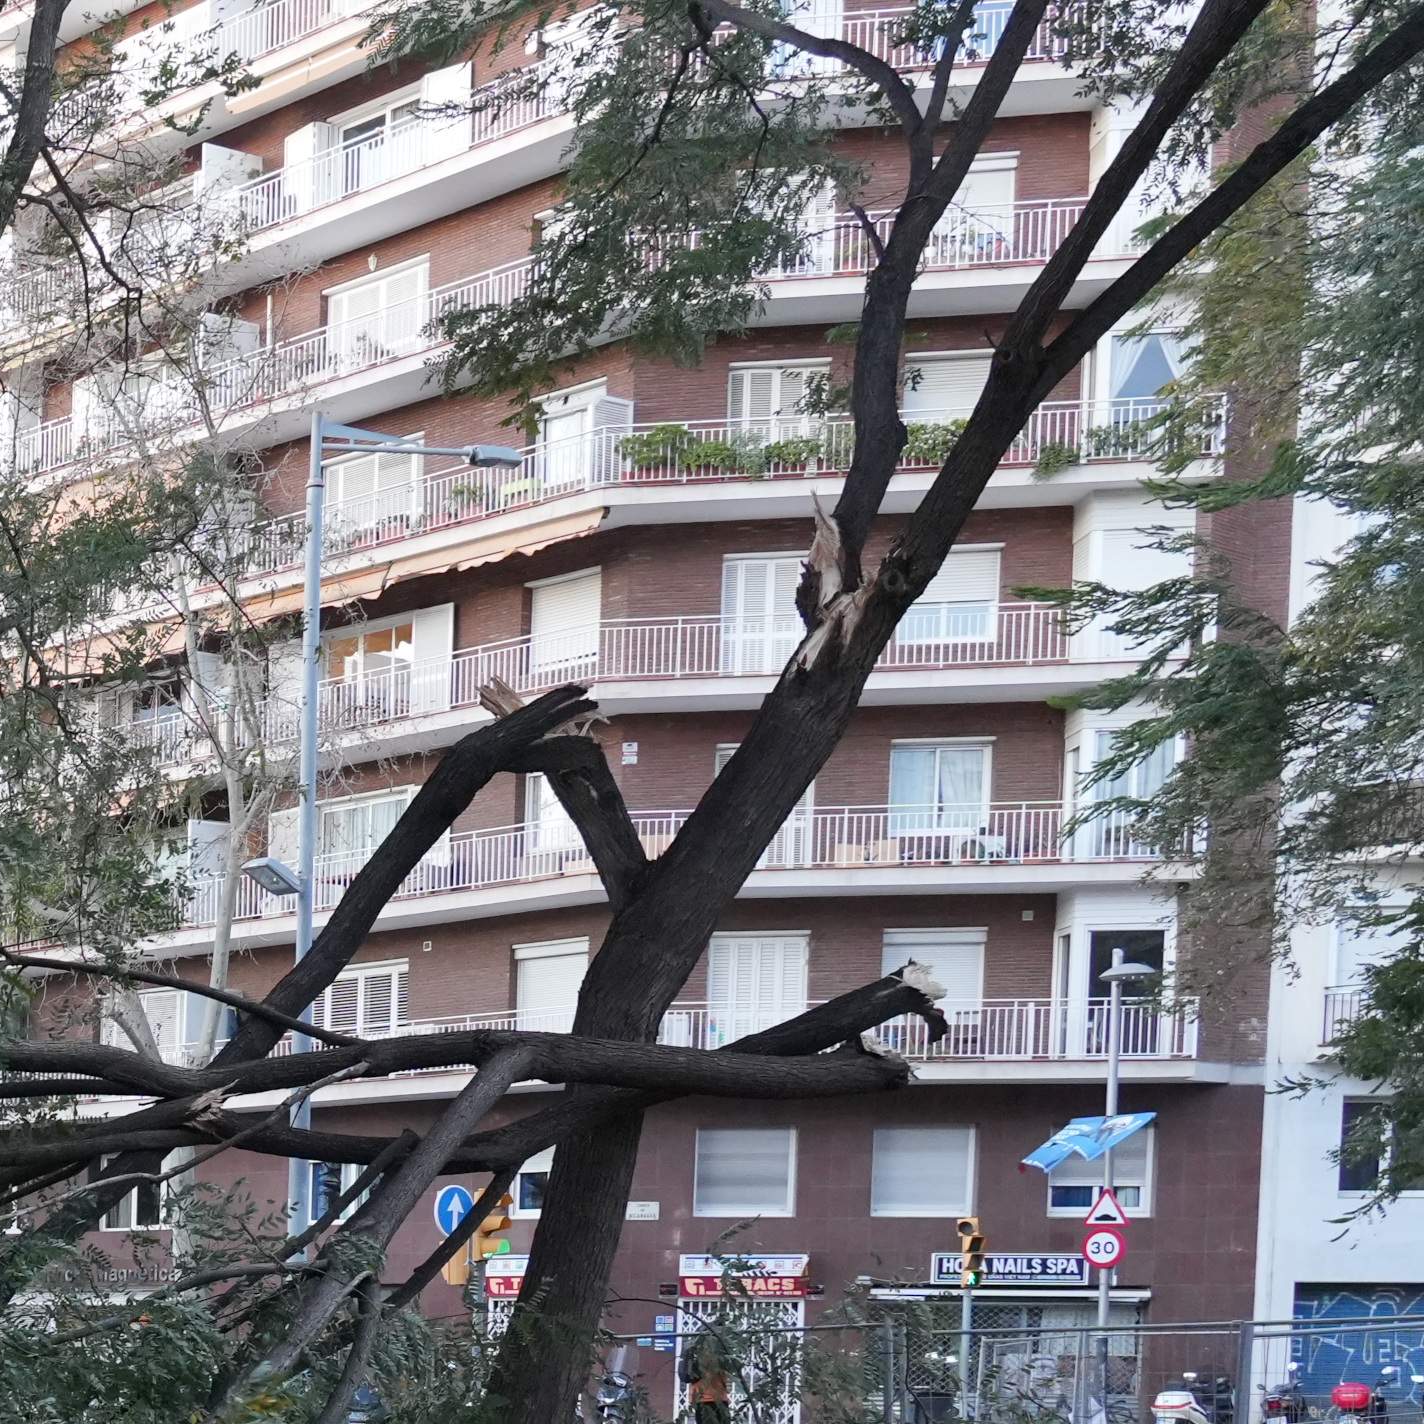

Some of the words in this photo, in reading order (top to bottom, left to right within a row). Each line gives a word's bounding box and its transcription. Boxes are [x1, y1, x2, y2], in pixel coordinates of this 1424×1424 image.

[1091, 1241, 1115, 1255] 30
[942, 1258, 989, 1273] HOA
[992, 1258, 1042, 1274] NAILS
[1046, 1258, 1079, 1274] SPA
